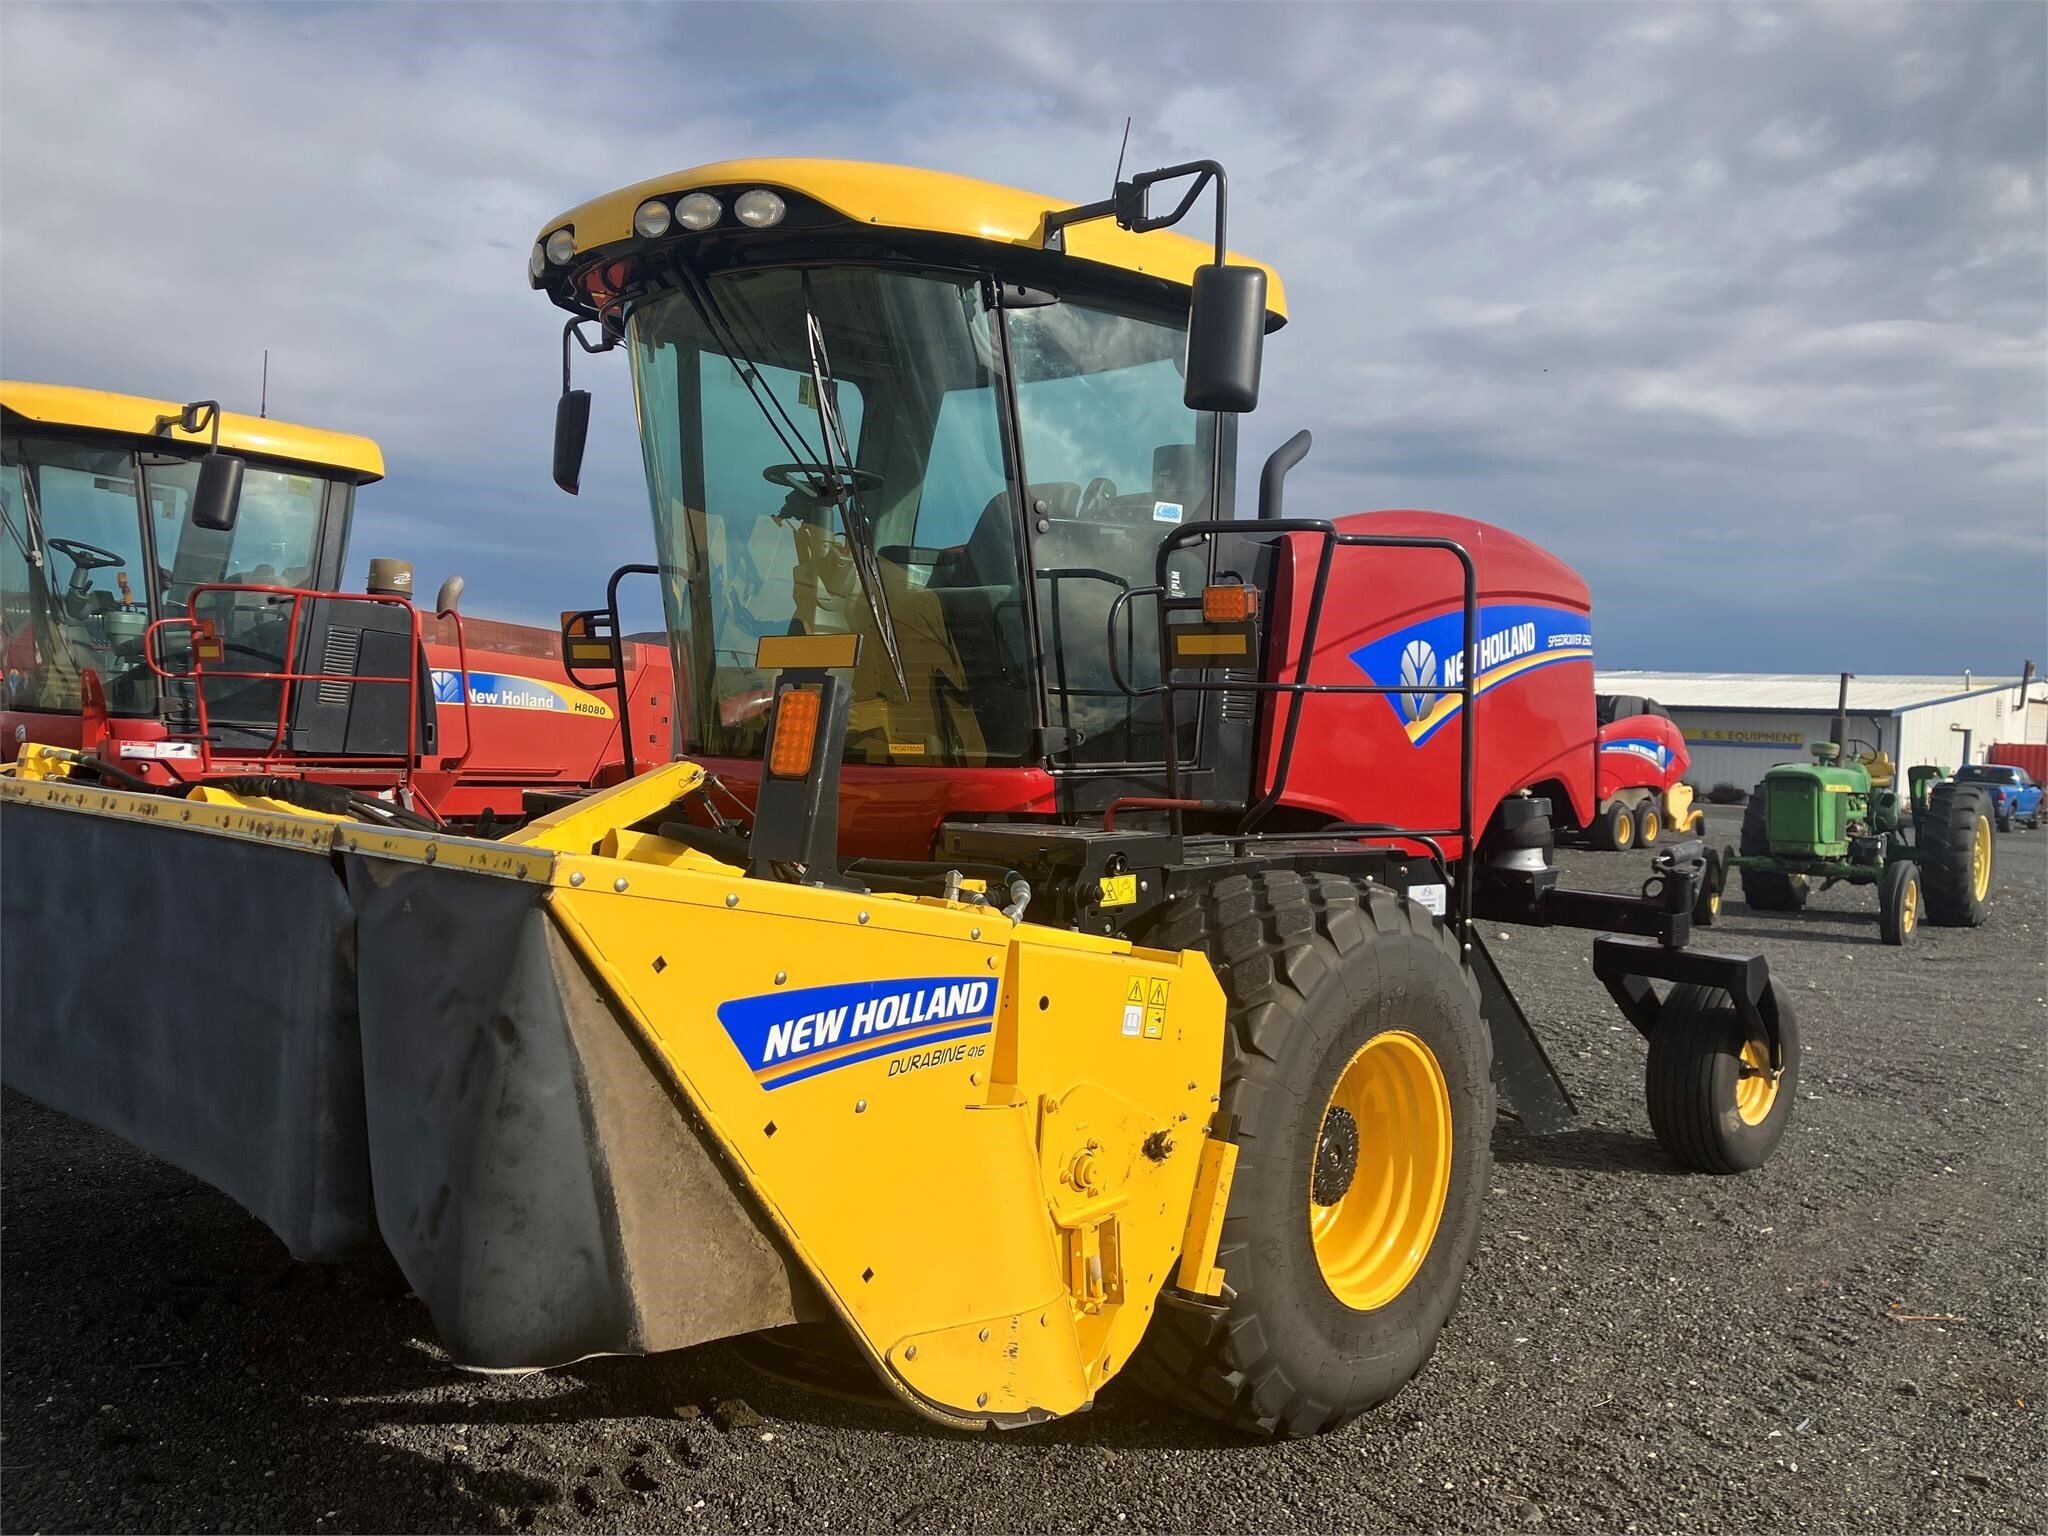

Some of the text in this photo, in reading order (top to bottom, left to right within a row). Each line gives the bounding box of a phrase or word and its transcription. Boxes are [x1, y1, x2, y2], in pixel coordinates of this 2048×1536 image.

[1444, 622, 1535, 687] NE HOLLAND
[469, 688, 554, 709] New Holland
[574, 702, 606, 716] H8080
[1728, 731, 1800, 744] EQUIPMENT
[763, 982, 988, 1063] NEW HOLLAND
[888, 1044, 986, 1078] DURABINE 416
